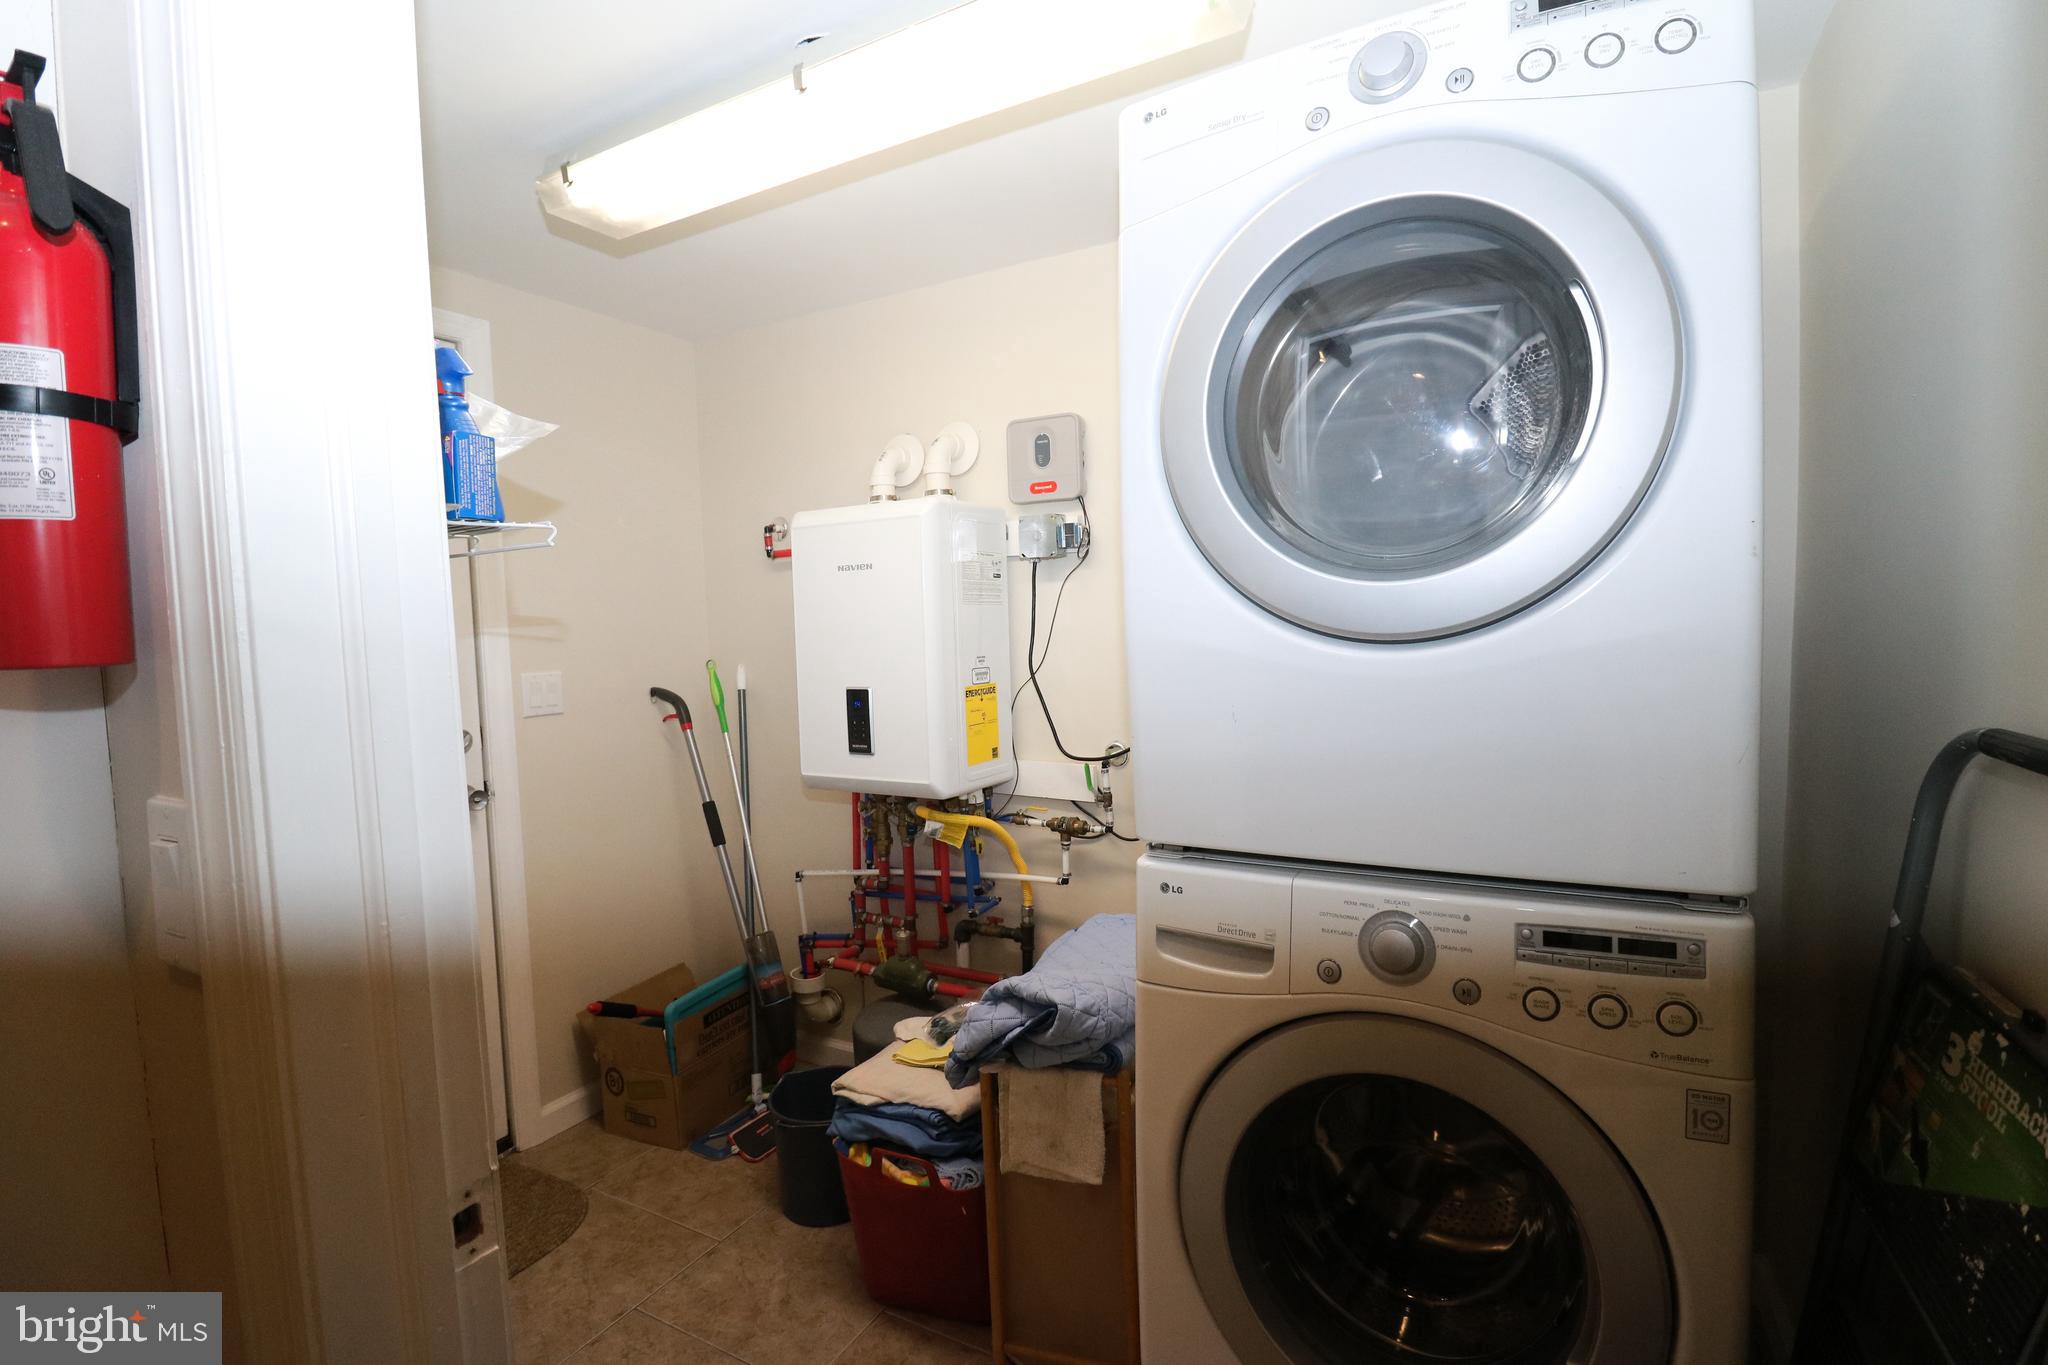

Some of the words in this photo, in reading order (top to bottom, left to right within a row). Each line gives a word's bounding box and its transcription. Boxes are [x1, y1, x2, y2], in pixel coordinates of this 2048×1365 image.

[1155, 107, 1168, 119] LG
[1171, 885, 1184, 895] LG
[1941, 1031, 1966, 1078] 3
[1959, 1073, 2008, 1135] STOOL
